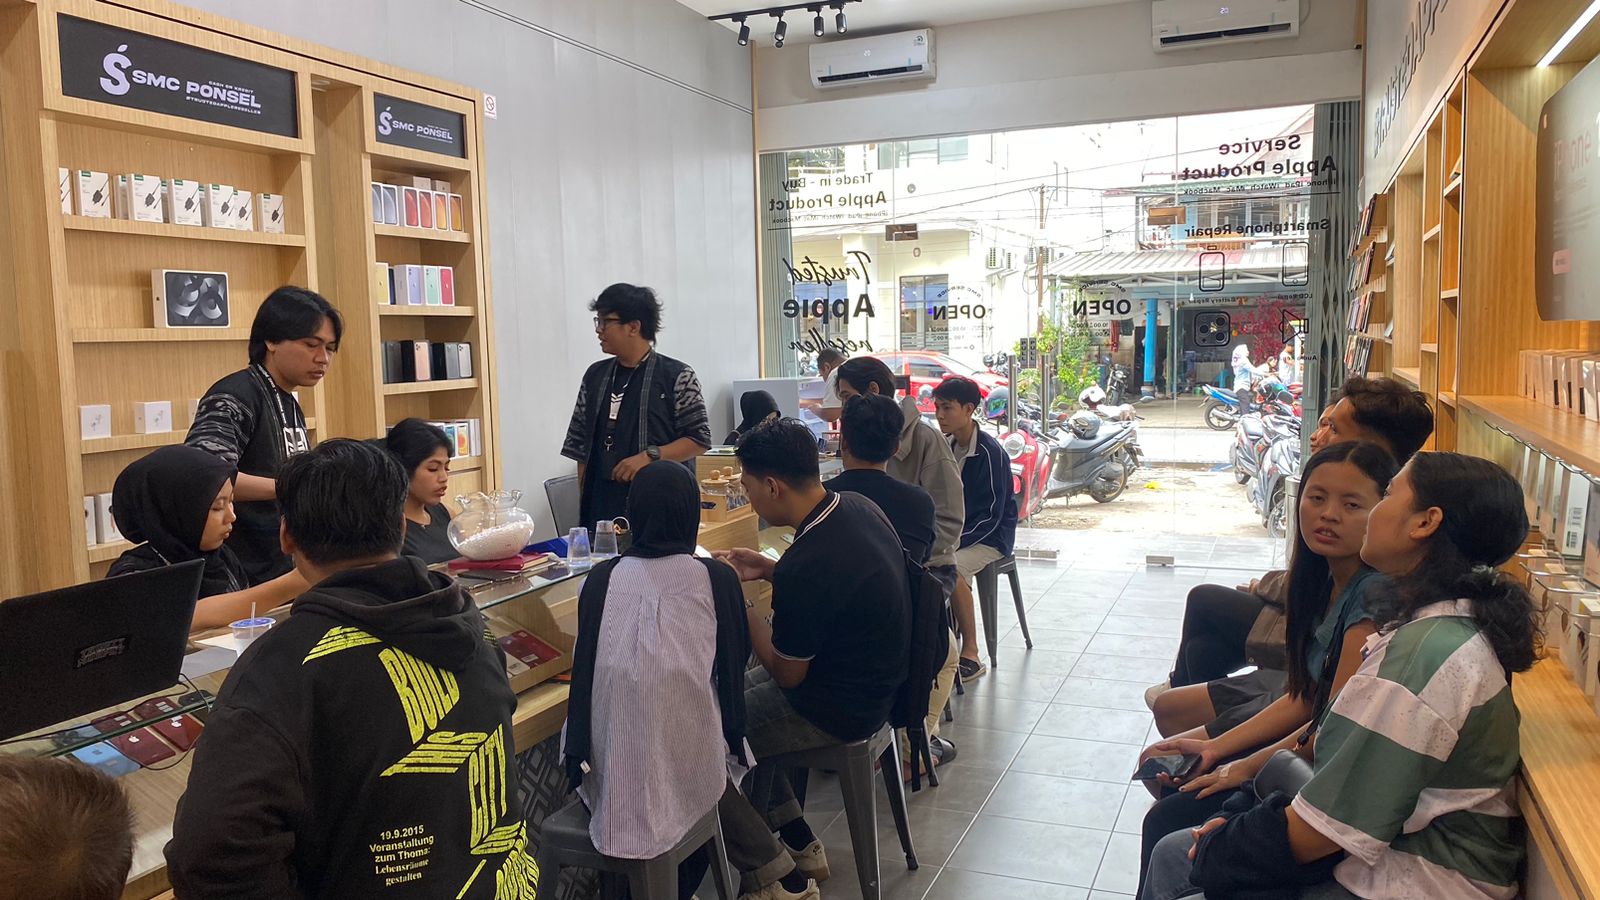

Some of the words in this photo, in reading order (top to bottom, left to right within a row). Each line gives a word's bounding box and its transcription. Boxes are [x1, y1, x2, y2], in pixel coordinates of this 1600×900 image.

[132, 69, 181, 91] SMC
[186, 80, 262, 109] PONSEL
[392, 120, 415, 132] SMC
[416, 125, 453, 140] PONSEL
[380, 824, 425, 841] 19.9.2015
[375, 853, 396, 863] zum
[385, 872, 422, 887] gestalten
